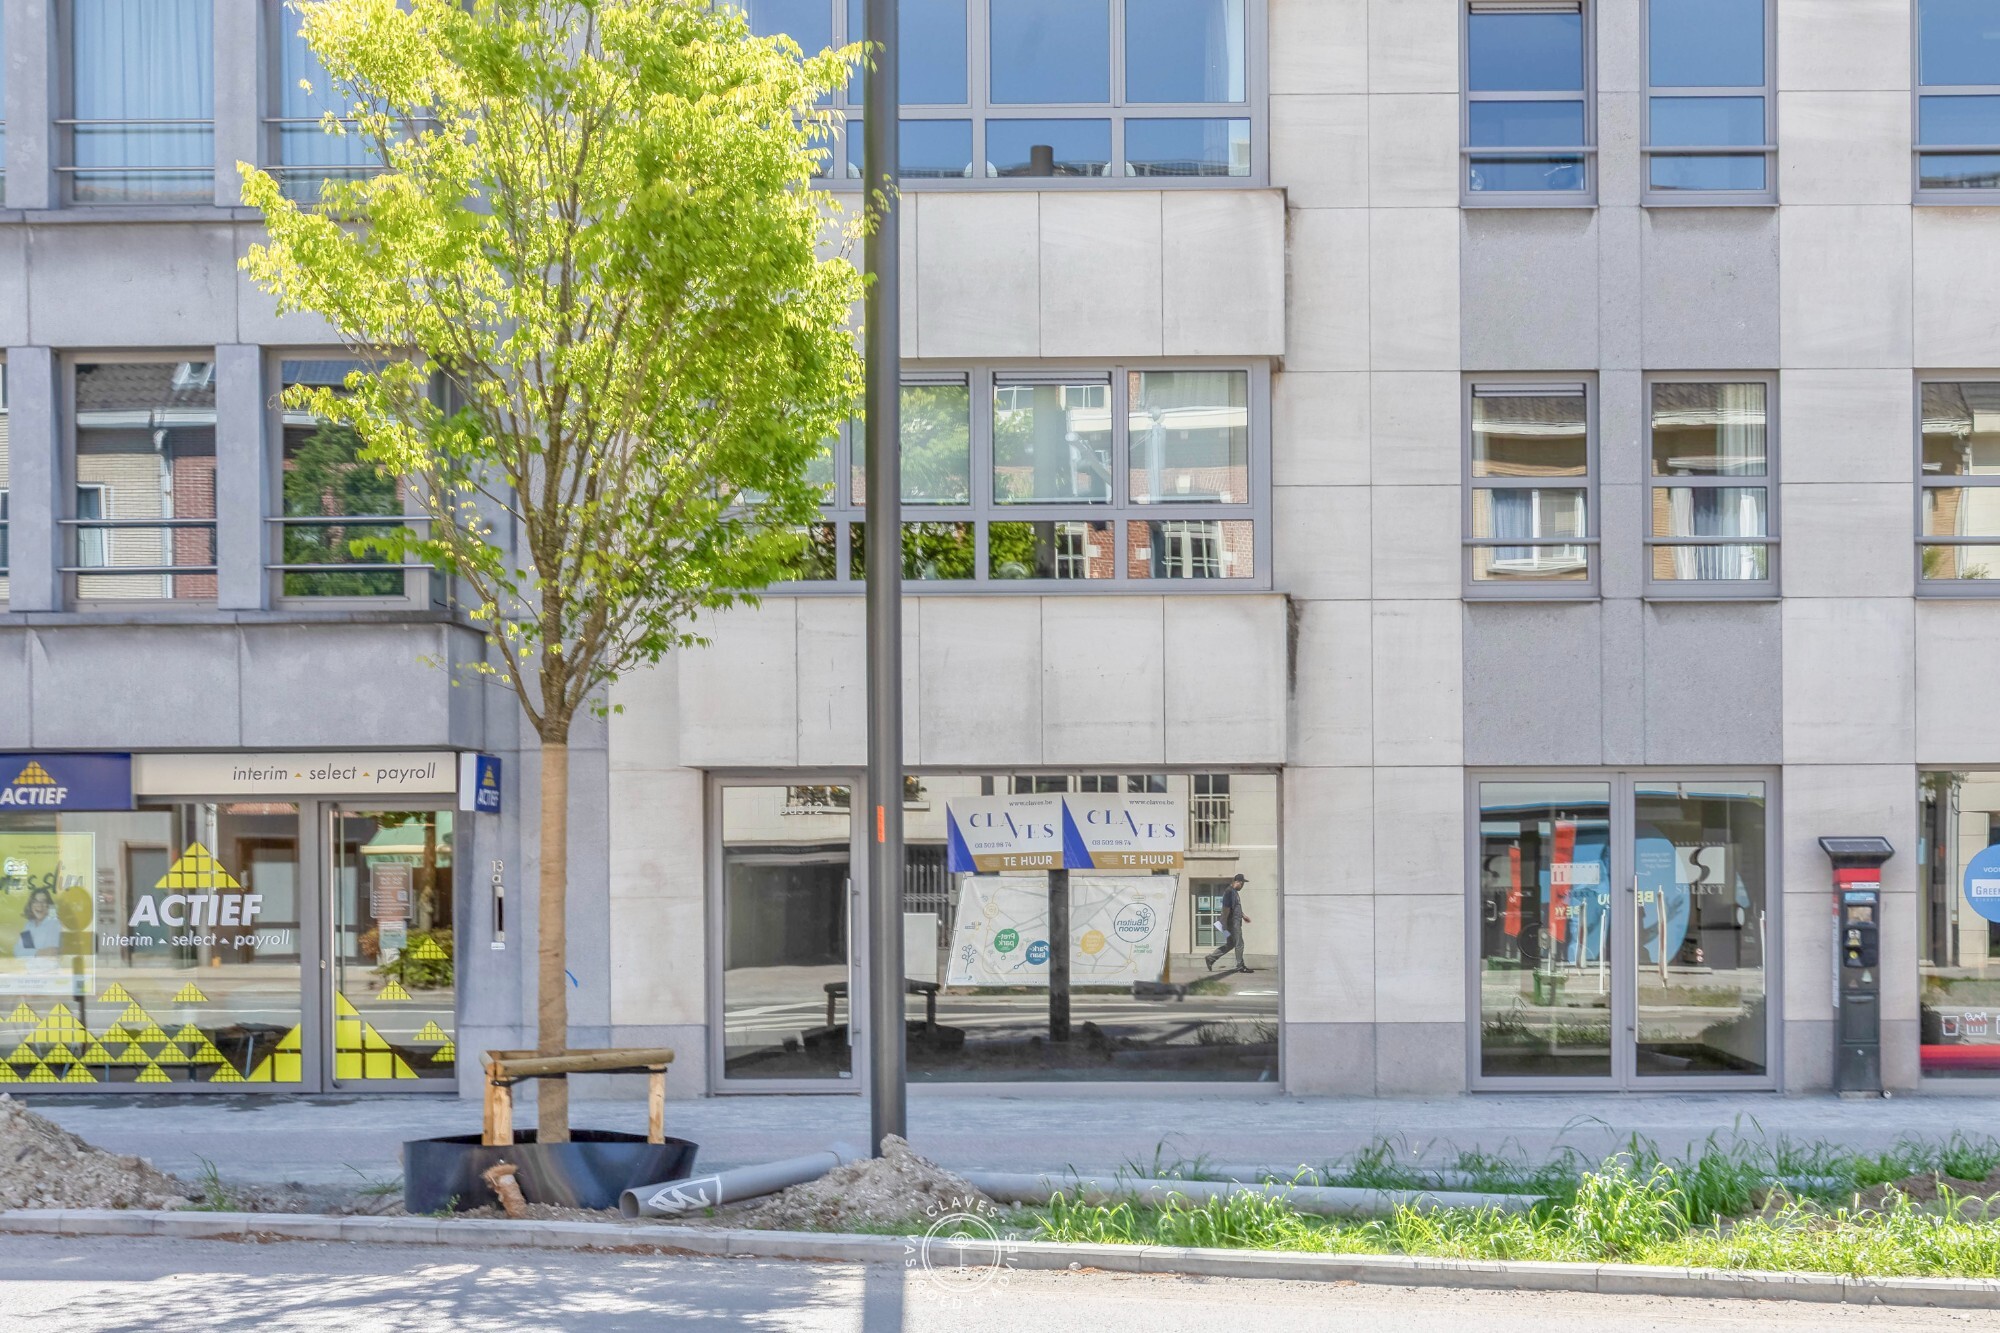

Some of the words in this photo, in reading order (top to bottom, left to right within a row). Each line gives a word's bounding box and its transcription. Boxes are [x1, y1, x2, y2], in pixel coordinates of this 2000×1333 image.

[232, 766, 288, 781] interim
[309, 763, 357, 780] select
[376, 762, 436, 784] payroll
[0, 787, 69, 805] ACTIEF
[969, 812, 1054, 839] CLAVES
[1086, 809, 1176, 838] CLAVES
[491, 860, 504, 873] 13
[1003, 856, 1017, 867] TE
[1020, 855, 1053, 866] HUUR
[1122, 855, 1136, 865] TE
[1140, 855, 1174, 865] HUUR
[1553, 871, 1565, 882] 11
[1675, 884, 1725, 895] SELECT
[128, 894, 263, 927] ACTIEF
[102, 932, 153, 947] interim
[171, 930, 218, 947] select
[233, 929, 290, 950] payroll
